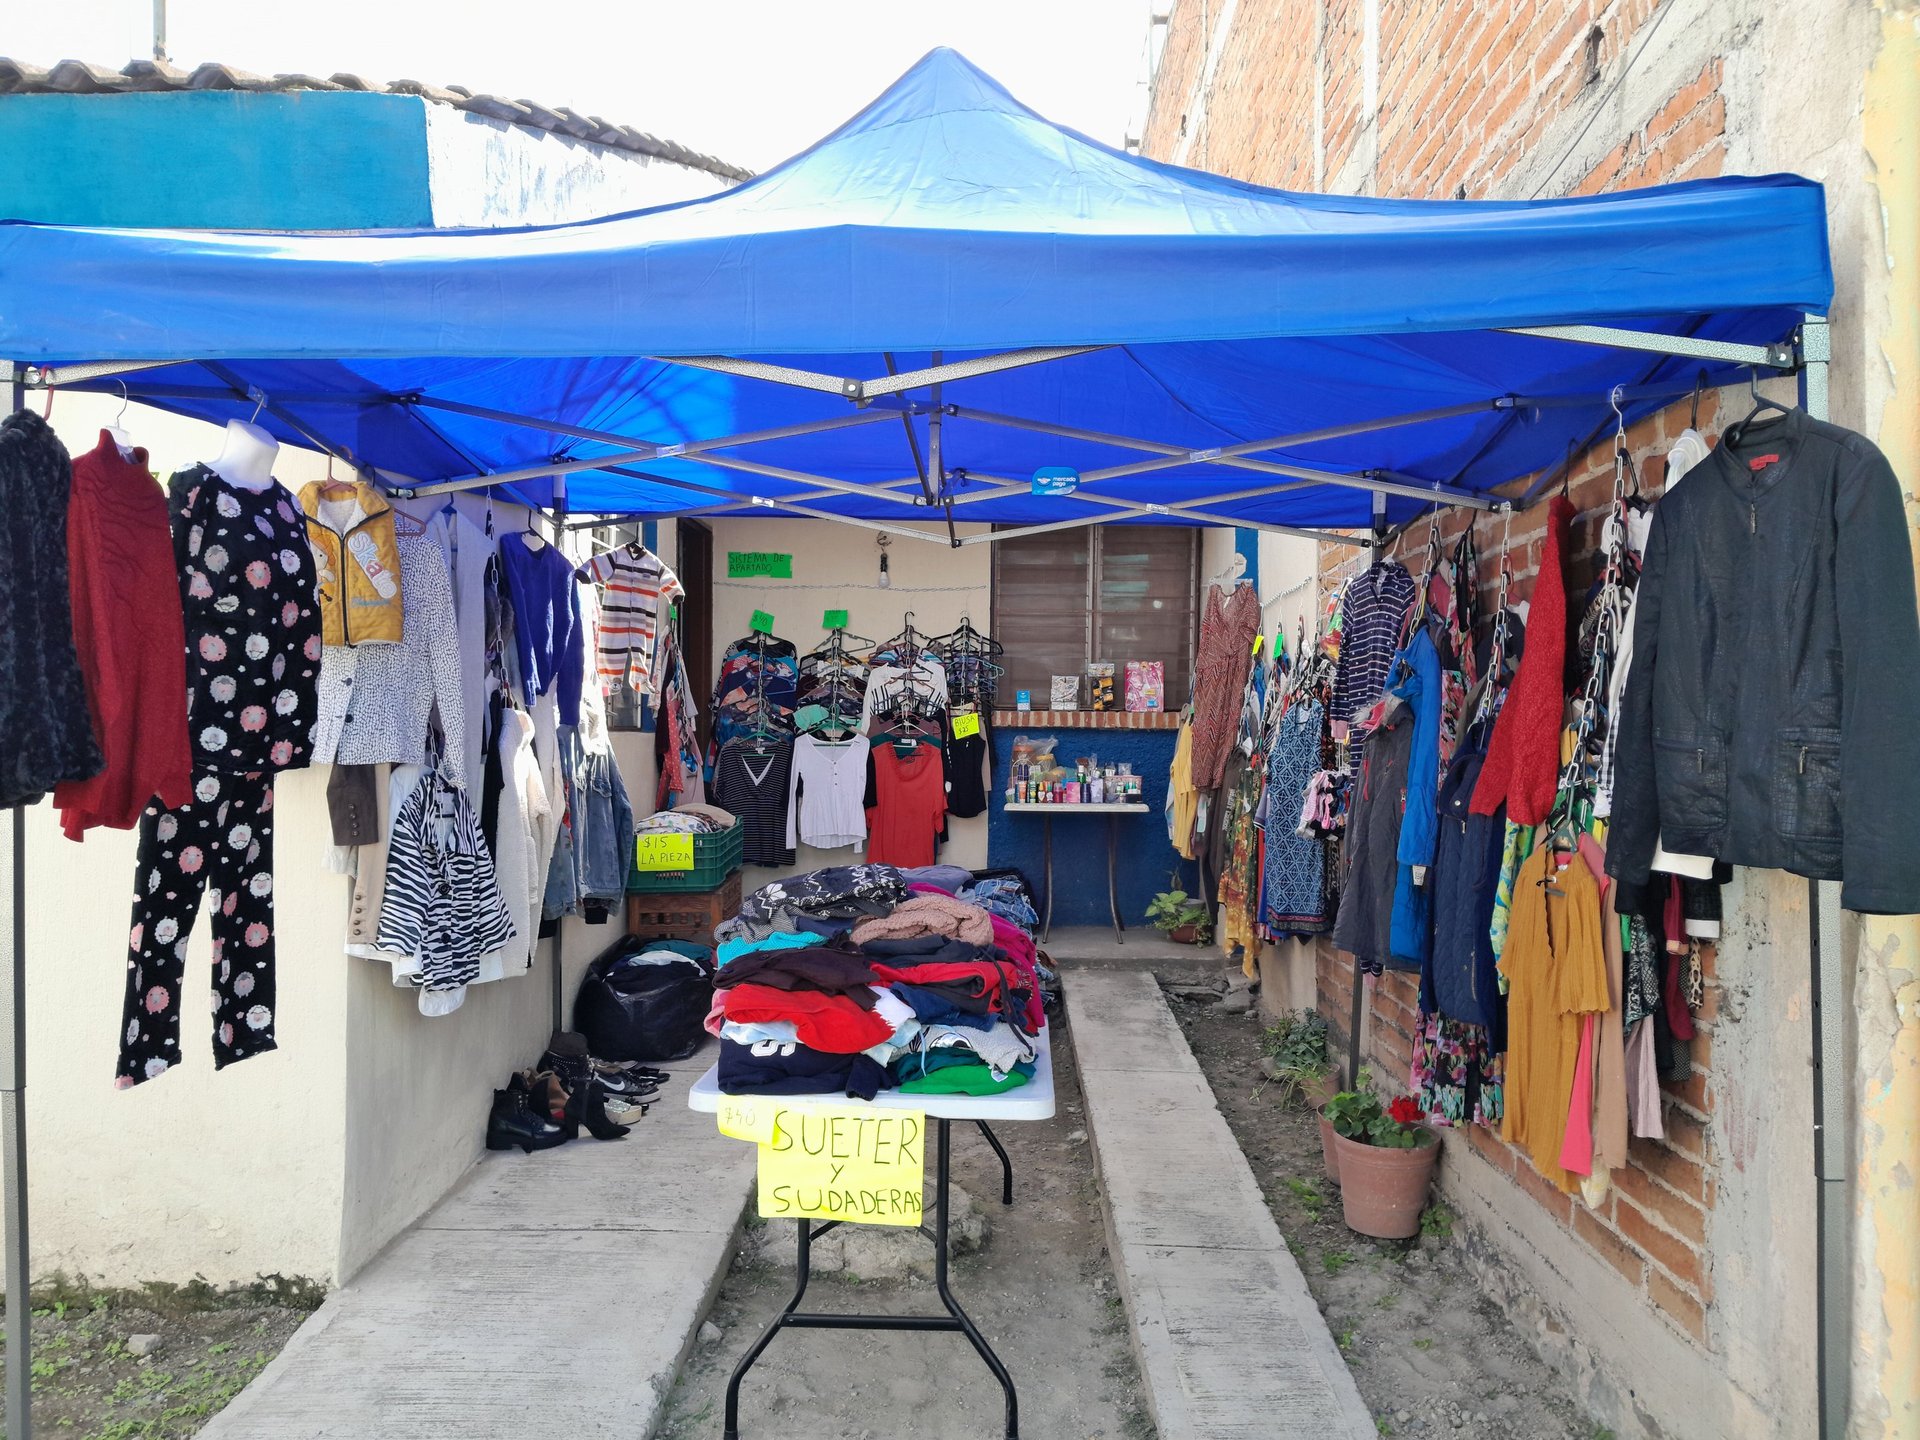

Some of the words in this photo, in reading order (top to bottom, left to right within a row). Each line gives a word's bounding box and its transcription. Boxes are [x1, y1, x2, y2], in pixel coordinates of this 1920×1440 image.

[728, 552, 768, 563] SISTEMA
[773, 553, 785, 562] DE
[729, 563, 773, 573] APARTADO
[643, 835, 669, 849] $15
[641, 852, 656, 865] LA
[660, 852, 691, 863] PIEZA
[772, 1110, 918, 1165] SUETER
[830, 1163, 845, 1184] Y
[773, 1185, 922, 1215] SUDADERAS
